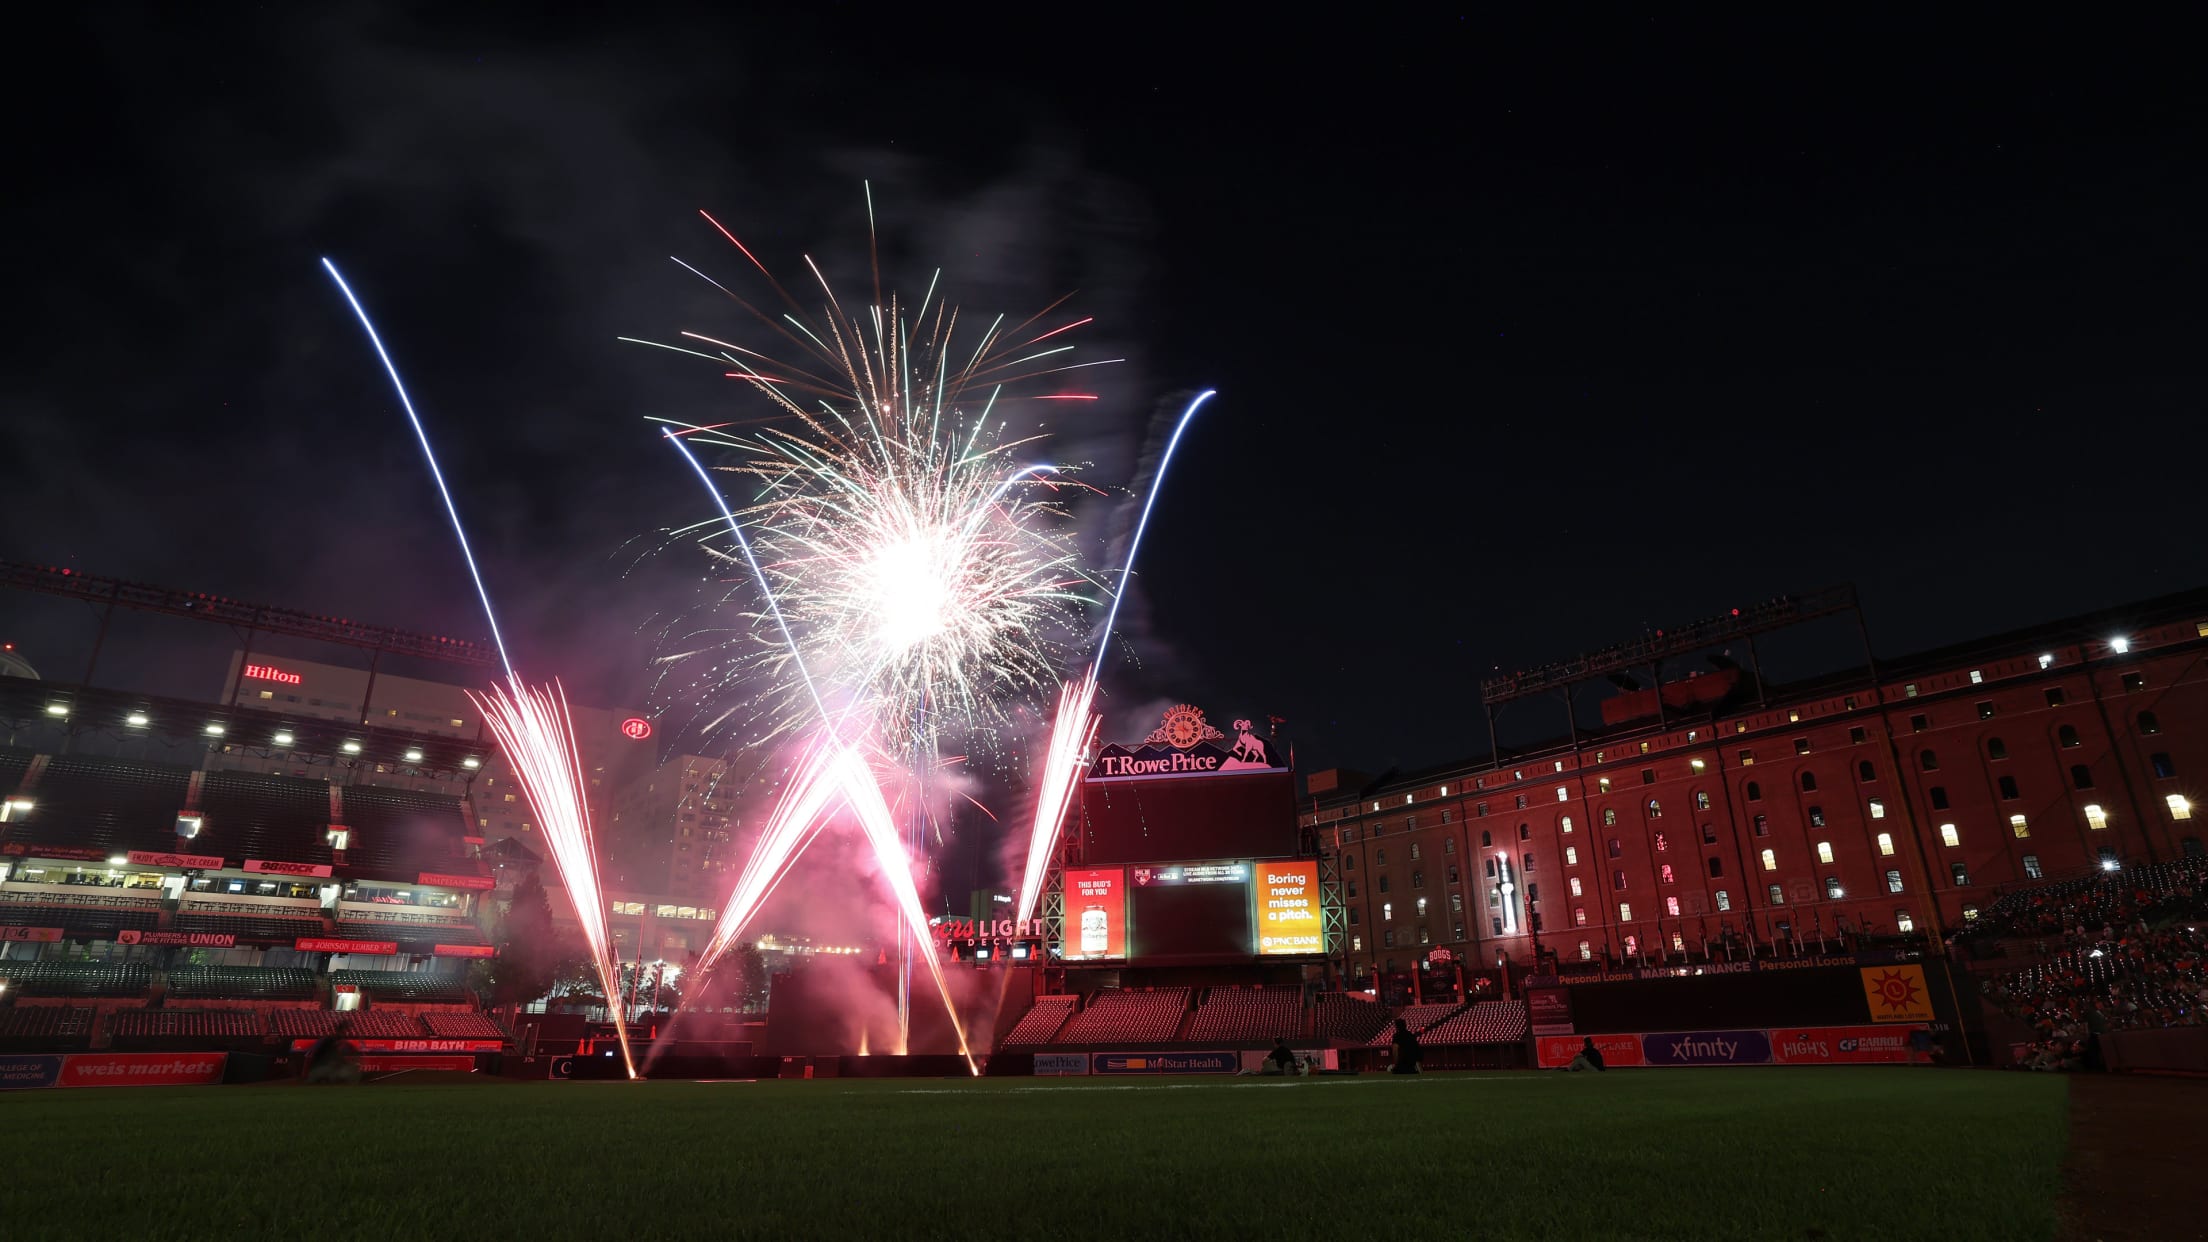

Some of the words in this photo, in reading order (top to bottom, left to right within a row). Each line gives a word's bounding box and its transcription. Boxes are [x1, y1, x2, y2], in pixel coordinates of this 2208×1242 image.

[245, 665, 301, 684] Hilton
[1163, 704, 1204, 720] ORIOLES
[186, 858, 196, 867] ICE
[197, 859, 219, 868] CREAM
[1078, 881, 1092, 889] THIS
[1093, 880, 1111, 888] BUD'S
[1267, 873, 1306, 885] Boring
[1095, 888, 1107, 896] YOU
[1271, 887, 1305, 896] never
[1268, 898, 1309, 908] misses
[1268, 912, 1277, 920] a
[1279, 909, 1313, 922] pitch.
[979, 918, 1042, 938] LIGHT
[190, 933, 235, 945] UNION
[968, 937, 1014, 947] DECK
[1273, 937, 1292, 945] PNC
[1294, 936, 1319, 944] BANK
[315, 941, 349, 951] JOHNSON
[1558, 973, 1601, 985] Personal
[1603, 972, 1634, 982] Loans
[1695, 961, 1751, 975] FINANCE
[1758, 958, 1815, 971] Personal
[1816, 955, 1856, 967] Loans
[394, 1040, 428, 1051] BIRD
[430, 1040, 466, 1051] BATH
[1608, 1042, 1633, 1051] LAKE
[1671, 1036, 1738, 1060] xfinity
[1782, 1041, 1830, 1058] HIGH'S
[76, 1061, 125, 1076] weis
[127, 1060, 215, 1076] markets
[1188, 1057, 1222, 1068] Health
[4, 1072, 45, 1081] MEDICINE
